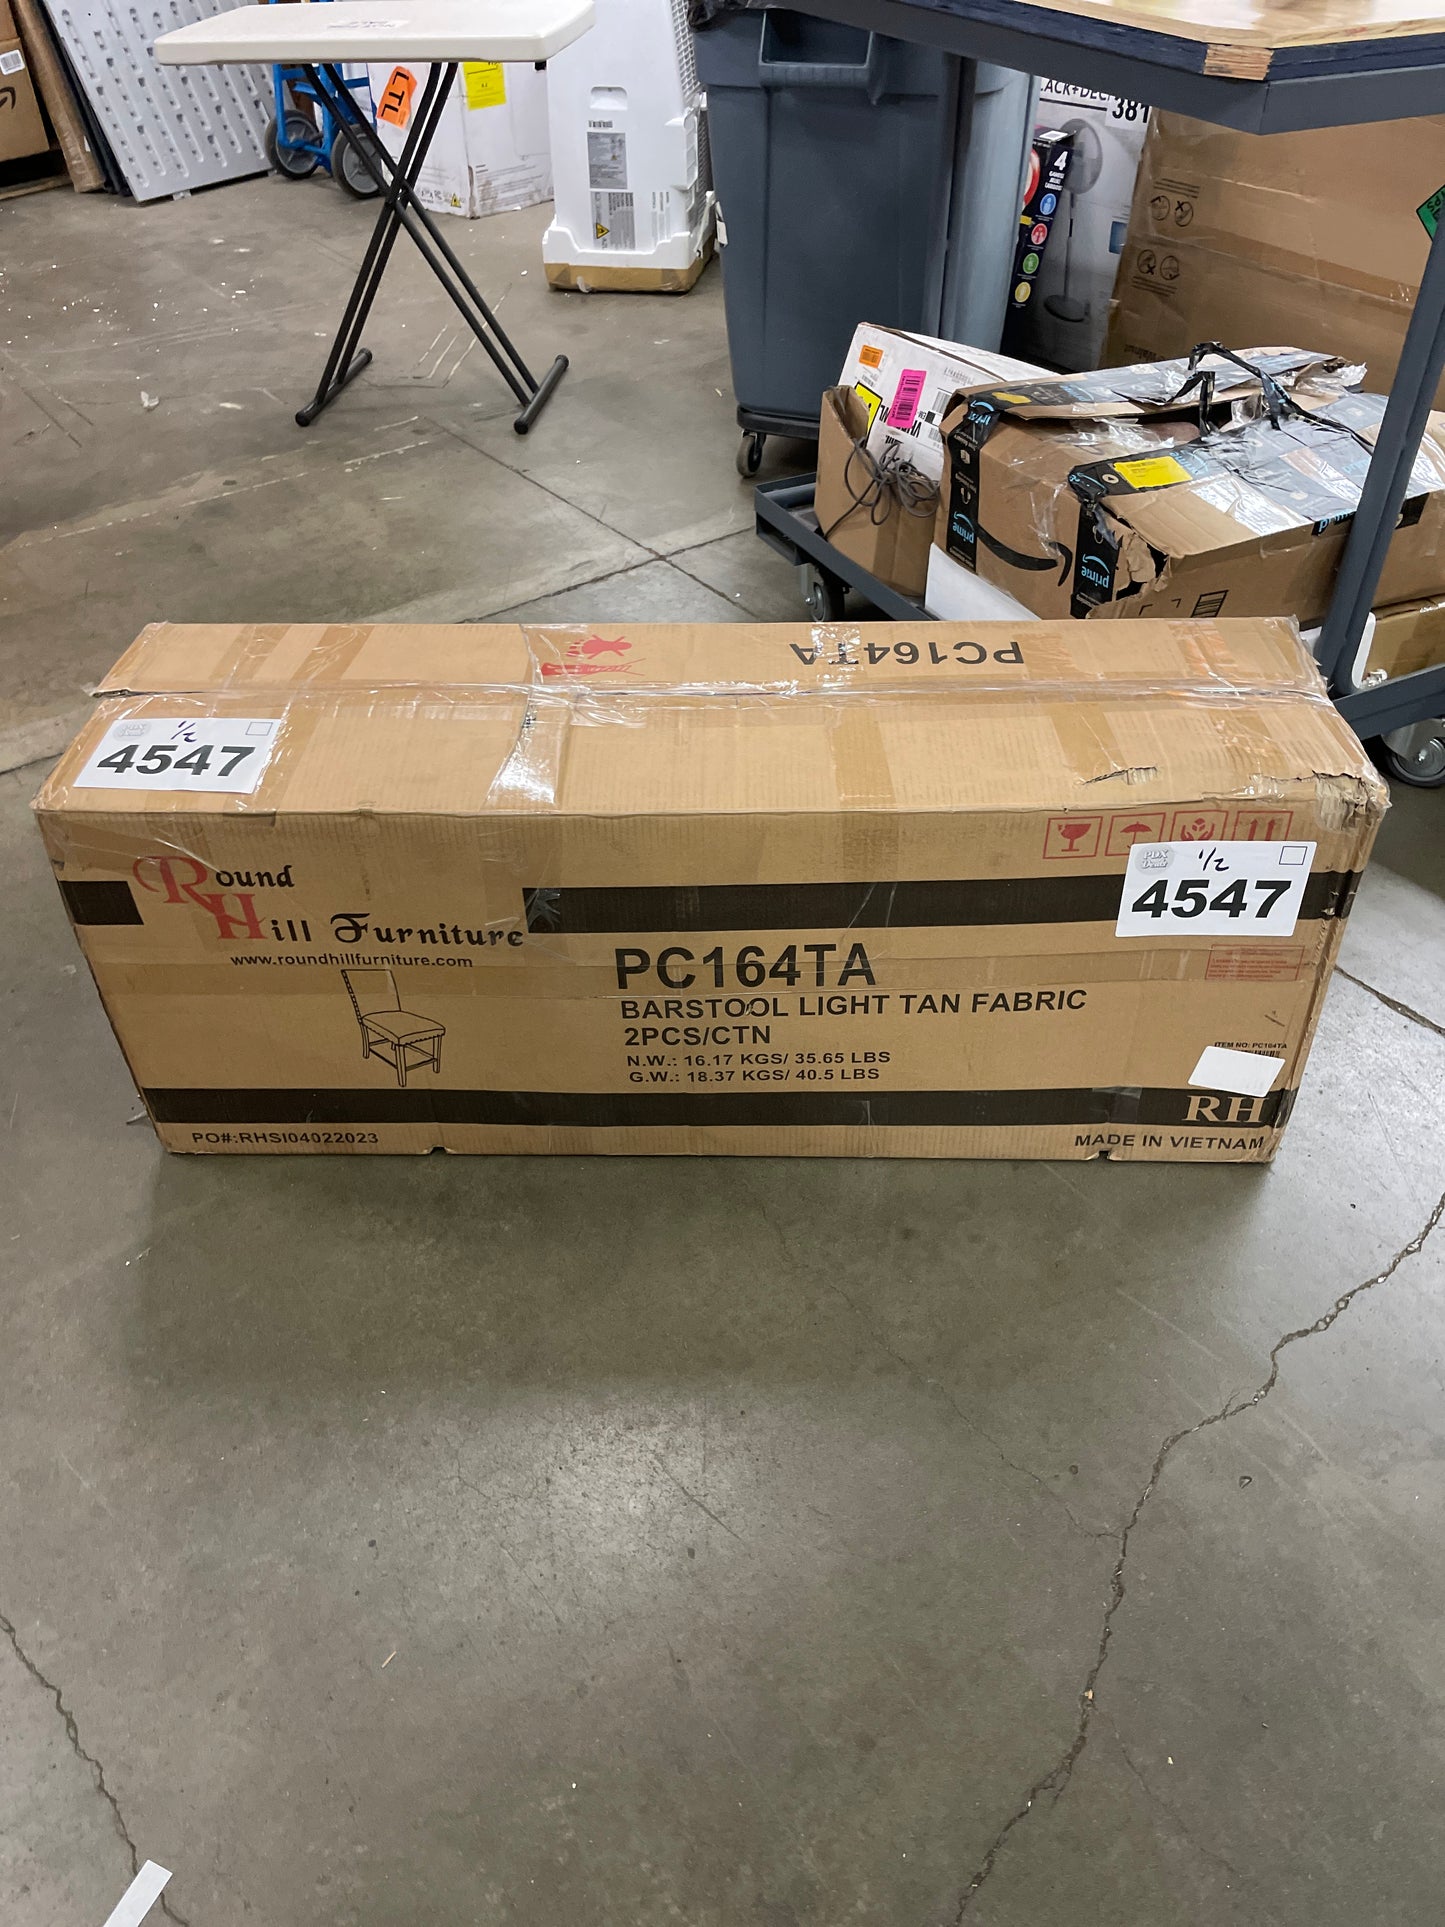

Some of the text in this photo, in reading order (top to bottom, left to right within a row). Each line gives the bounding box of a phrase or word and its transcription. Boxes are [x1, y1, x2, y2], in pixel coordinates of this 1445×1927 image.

[380, 70, 410, 118] LTL
[1053, 150, 1068, 171] 4
[952, 521, 975, 545] prime
[1081, 565, 1110, 589] prime
[789, 641, 1025, 665] PC164TA
[97, 744, 256, 777] 4547
[1198, 847, 1230, 872] 1/2
[132, 855, 295, 905] Round
[1131, 879, 1292, 919] 4547
[206, 892, 524, 947] Hill Furniture
[230, 952, 474, 969] www.roundhillfurniture.com
[614, 942, 877, 990] PC164TA
[621, 989, 1088, 1019] BARSTOOL LIGHT TAN FABRIC
[624, 1025, 771, 1046] 2PCS/CTN
[627, 1051, 892, 1067] N.W.: 16.17 KGS/ 35.65 LBS
[629, 1068, 880, 1083] G.W.: 18.37 KGS/ 40.5 LBS
[1181, 1094, 1271, 1123] RH
[191, 1132, 379, 1144] PO#:RHSI04022023
[1074, 1134, 1266, 1150] MADE IN VIETNAM
